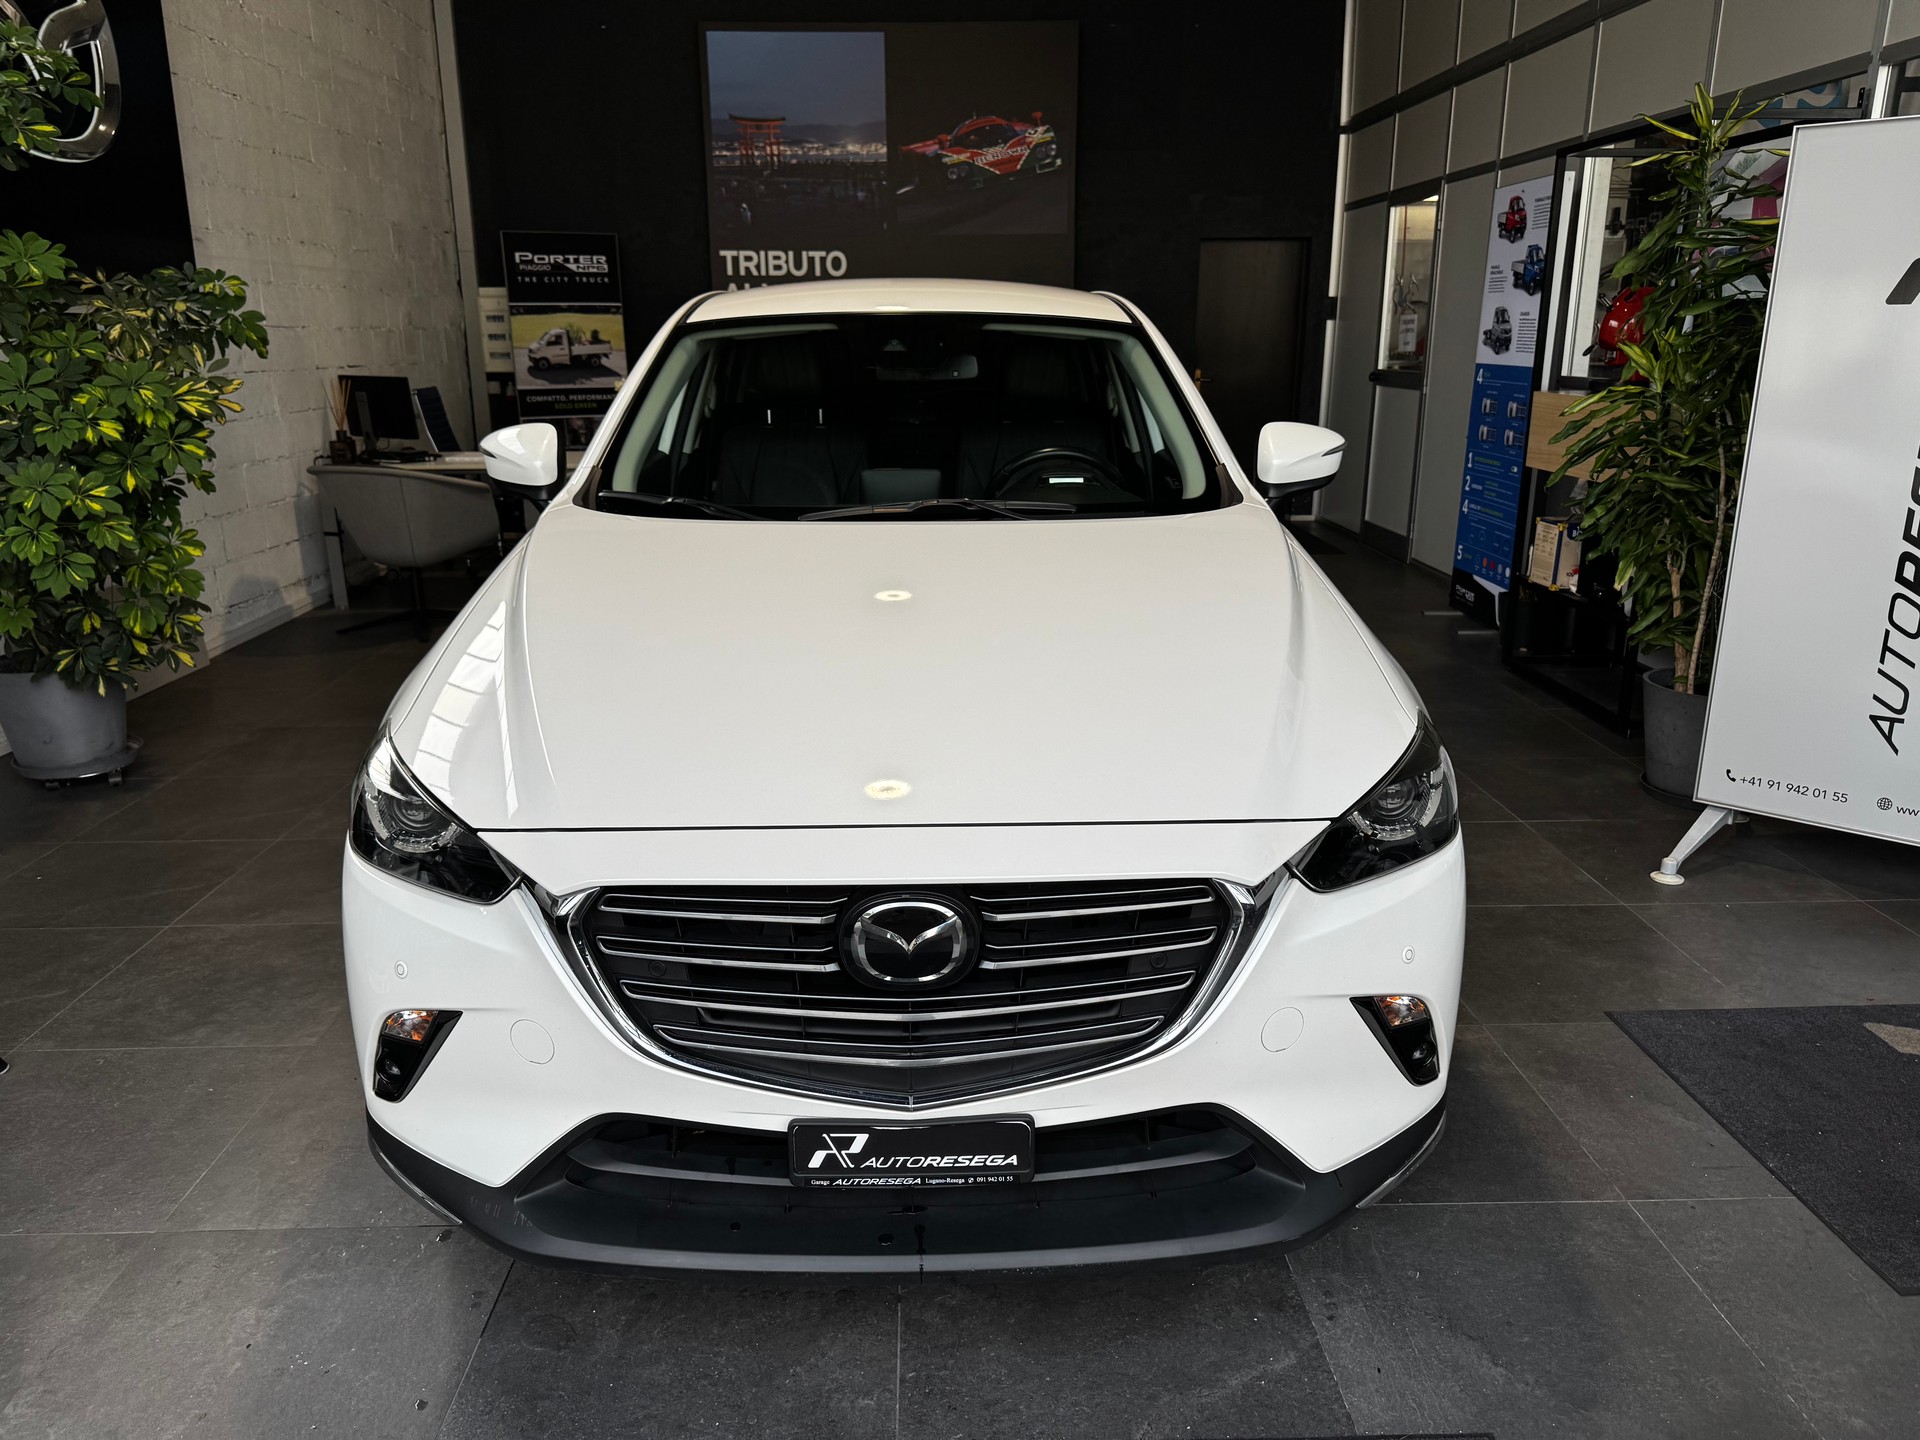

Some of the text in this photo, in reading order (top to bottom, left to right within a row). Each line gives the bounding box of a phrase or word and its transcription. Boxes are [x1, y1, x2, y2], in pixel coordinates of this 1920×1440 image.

[514, 251, 608, 265] PORTER
[719, 250, 848, 278] TRIBUTO
[519, 264, 552, 272] PIAGGIO
[516, 276, 610, 284] THE CITY TRUCK
[1476, 368, 1484, 385] 4
[1467, 452, 1473, 468] 1
[1464, 475, 1471, 491] 2
[1456, 544, 1463, 561] 5
[1740, 776, 1762, 788] +41
[1767, 779, 1781, 791] 91
[1786, 783, 1810, 796] 942
[1812, 788, 1827, 800] 01
[1832, 791, 1849, 803] 55
[860, 1154, 1018, 1169] AUTORESEGA
[811, 1178, 830, 1186] Garage
[832, 1177, 921, 1186] AUTORESEGA
[925, 1177, 965, 1185] Lugano-Resega
